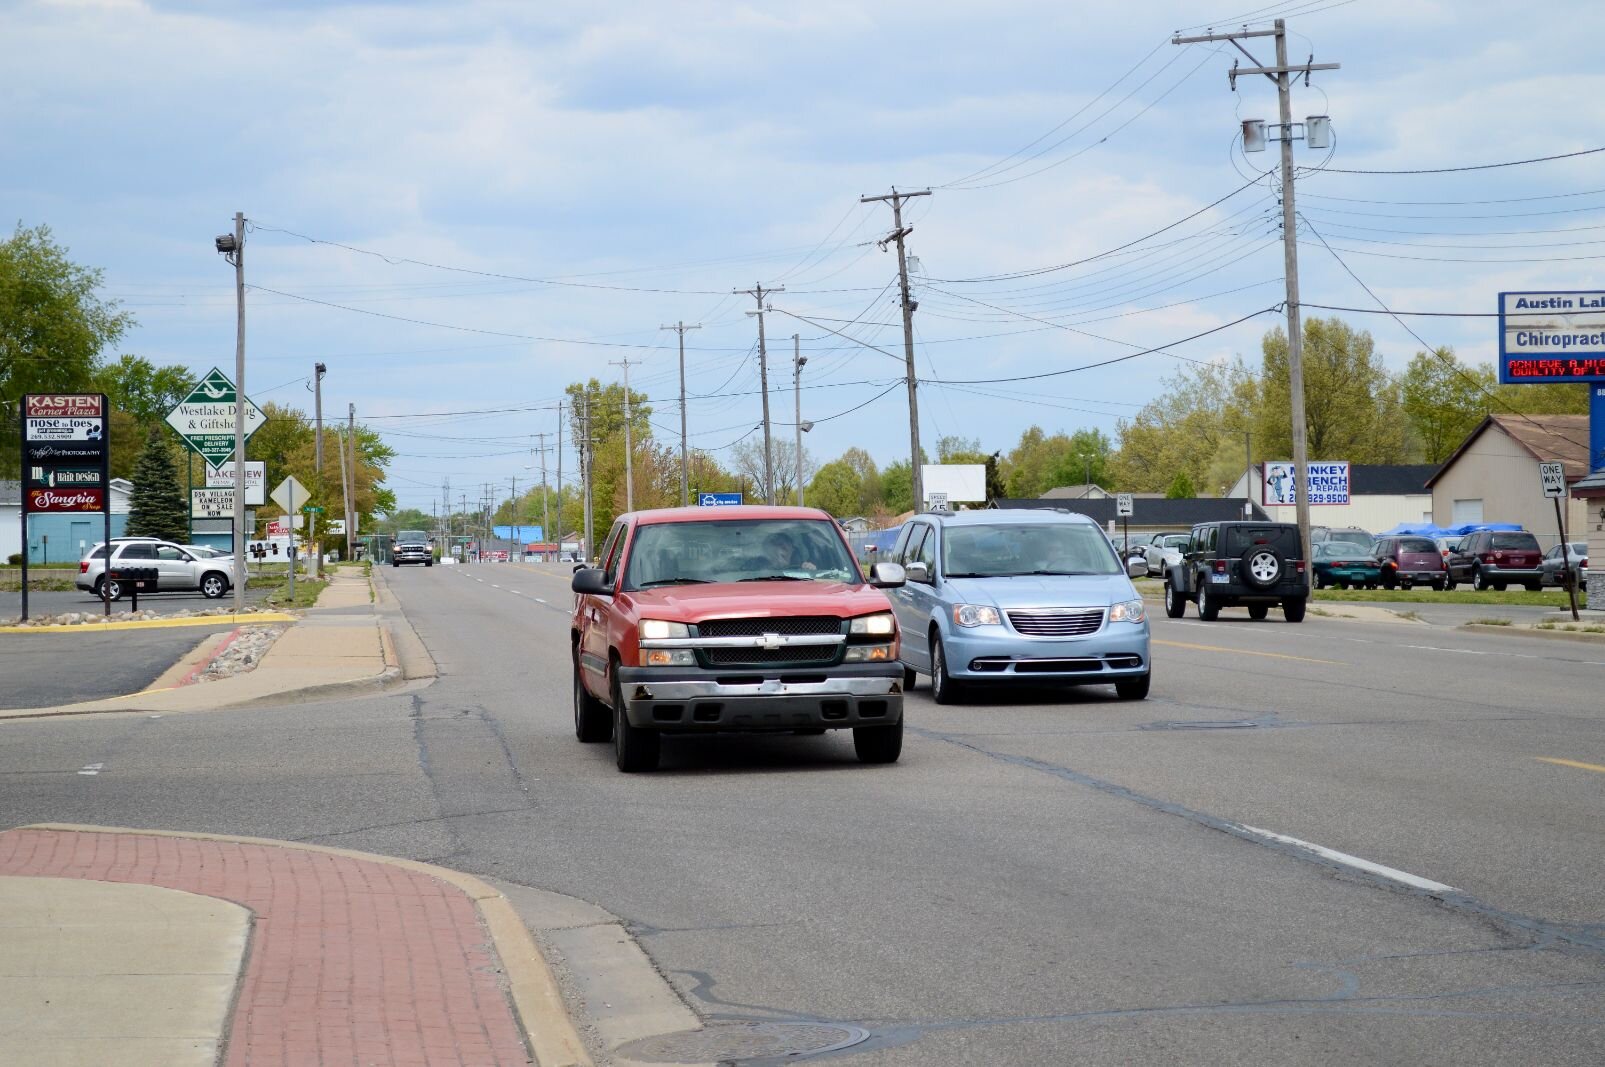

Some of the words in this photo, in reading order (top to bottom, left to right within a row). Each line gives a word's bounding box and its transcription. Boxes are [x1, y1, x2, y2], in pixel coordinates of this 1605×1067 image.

[1515, 296, 1573, 309] Austin
[1516, 331, 1605, 348] Chiropract
[1509, 360, 1562, 368] ACHIEVE
[1569, 360, 1577, 368] A
[1513, 368, 1565, 376] QUALITY
[1573, 368, 1588, 376] OF
[28, 396, 99, 407] KASTEN
[31, 407, 64, 416] Corner
[65, 406, 96, 416] Plaza
[179, 405, 225, 416] Westlake
[228, 405, 256, 420] Dug
[30, 419, 60, 428] nose
[70, 419, 93, 428] toes
[188, 419, 197, 429] &
[200, 418, 237, 429] Giftsho
[208, 470, 262, 478] LAKEIEW
[1290, 465, 1347, 475] MNKEY
[1542, 465, 1561, 474] ONE
[1292, 476, 1347, 486] ENCH
[1543, 475, 1562, 484] WAY
[35, 491, 97, 508] Sangria
